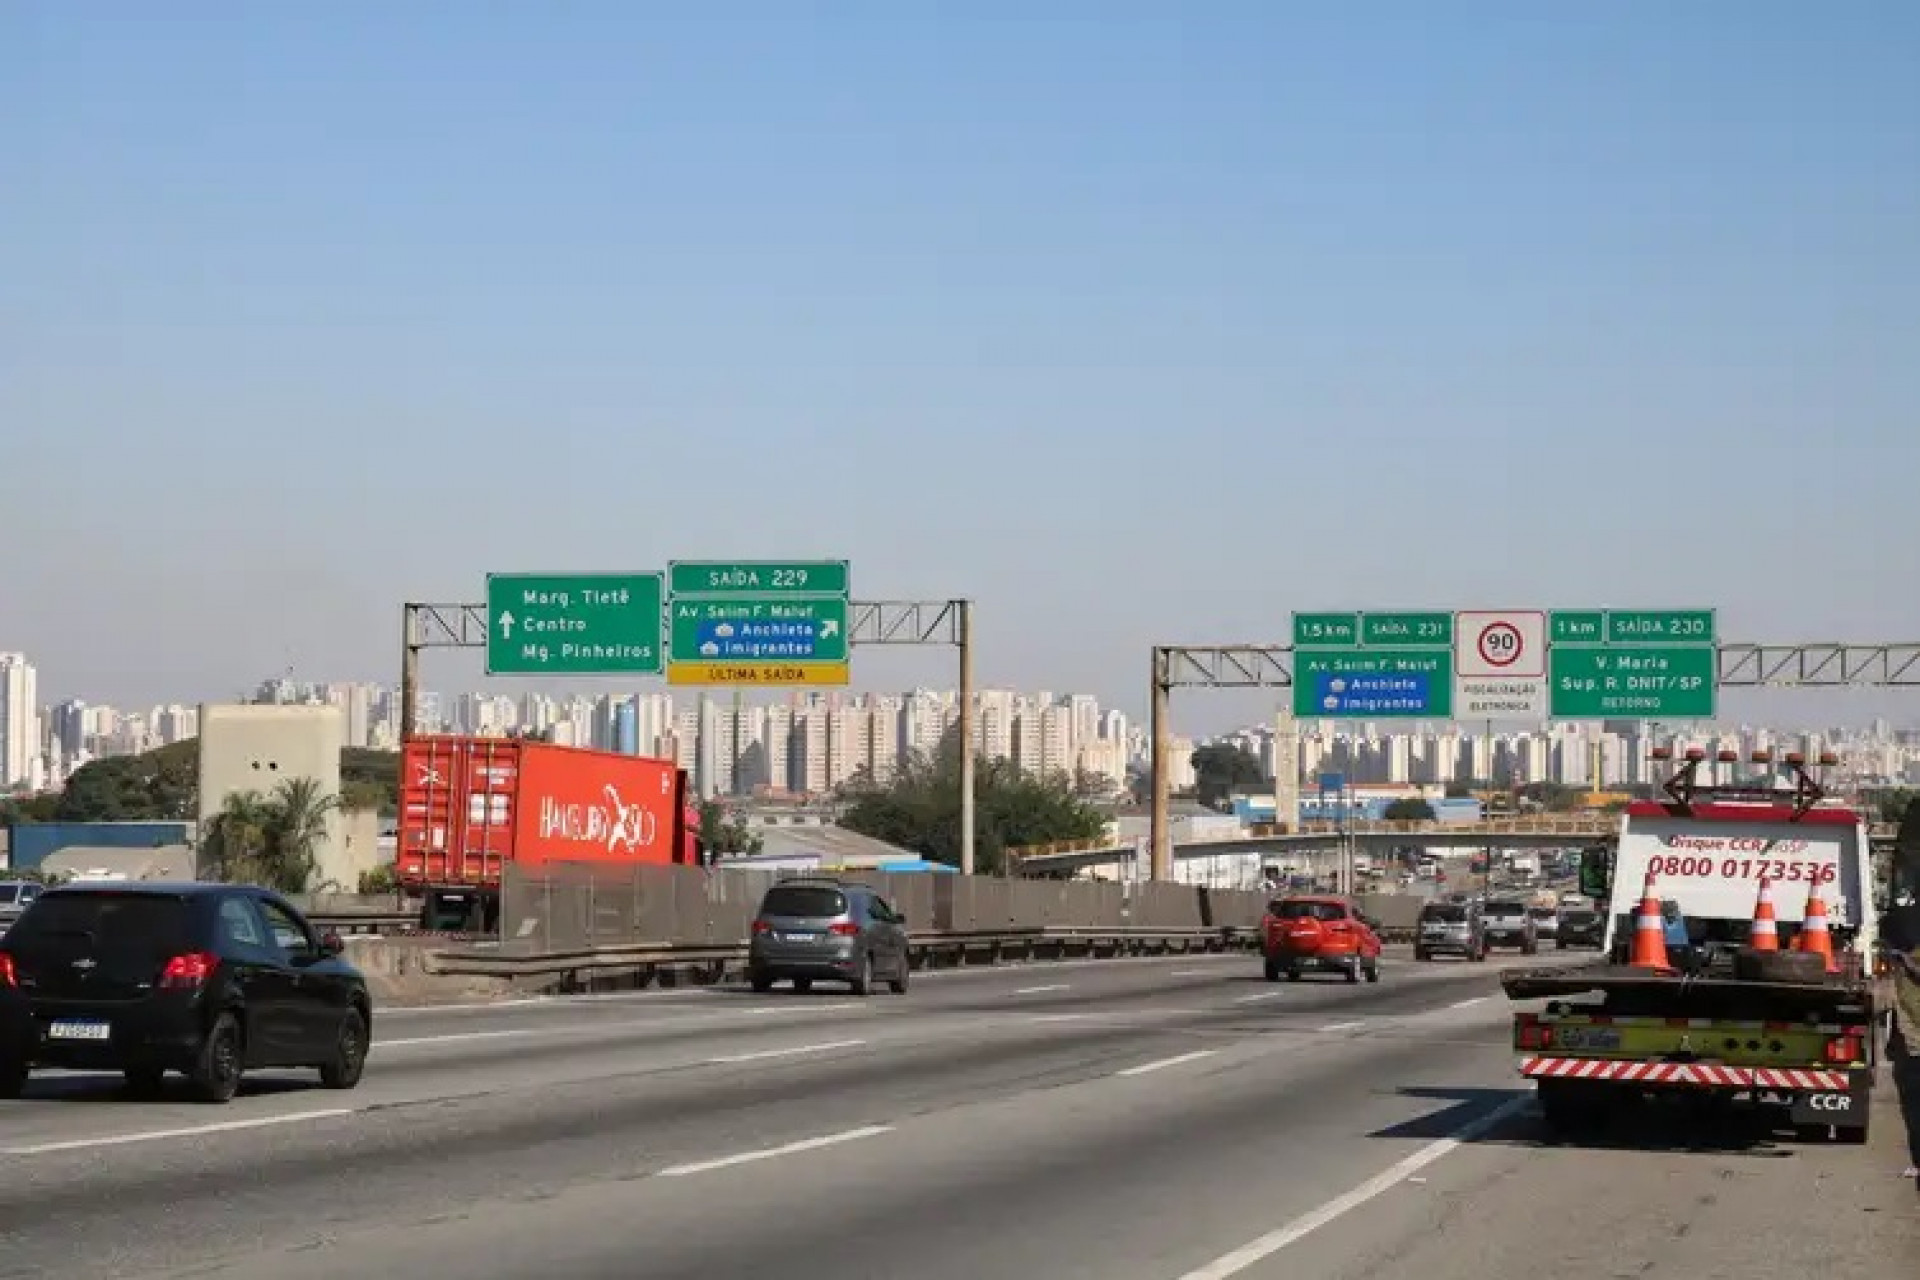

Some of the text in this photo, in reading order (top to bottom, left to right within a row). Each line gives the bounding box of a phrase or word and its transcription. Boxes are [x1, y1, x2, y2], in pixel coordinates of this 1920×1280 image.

[709, 565, 808, 586] SAÍDA 229
[581, 587, 630, 605] Tietê
[523, 616, 587, 632] Centro
[741, 623, 813, 637] Anchieta
[1326, 623, 1350, 636] km
[1417, 622, 1443, 637] 231
[1557, 620, 1595, 634] 1 km
[1616, 615, 1705, 635] SAÍDA 230
[725, 640, 813, 657] Imigrantes
[1486, 633, 1514, 650] 90
[562, 643, 652, 658] Pinheiros
[1617, 656, 1669, 670] Maria
[708, 665, 806, 681] ÚLTIMA SAÍDA
[1351, 678, 1417, 691] Anchieta
[1560, 676, 1600, 693] Sup.
[1343, 697, 1422, 711] Imigrantes
[1601, 696, 1661, 709] RETORNO
[1669, 835, 1725, 851] Disque
[1728, 838, 1761, 851] CCR
[1648, 855, 1837, 882] 0800 0173536
[1809, 1094, 1851, 1110] CCR
